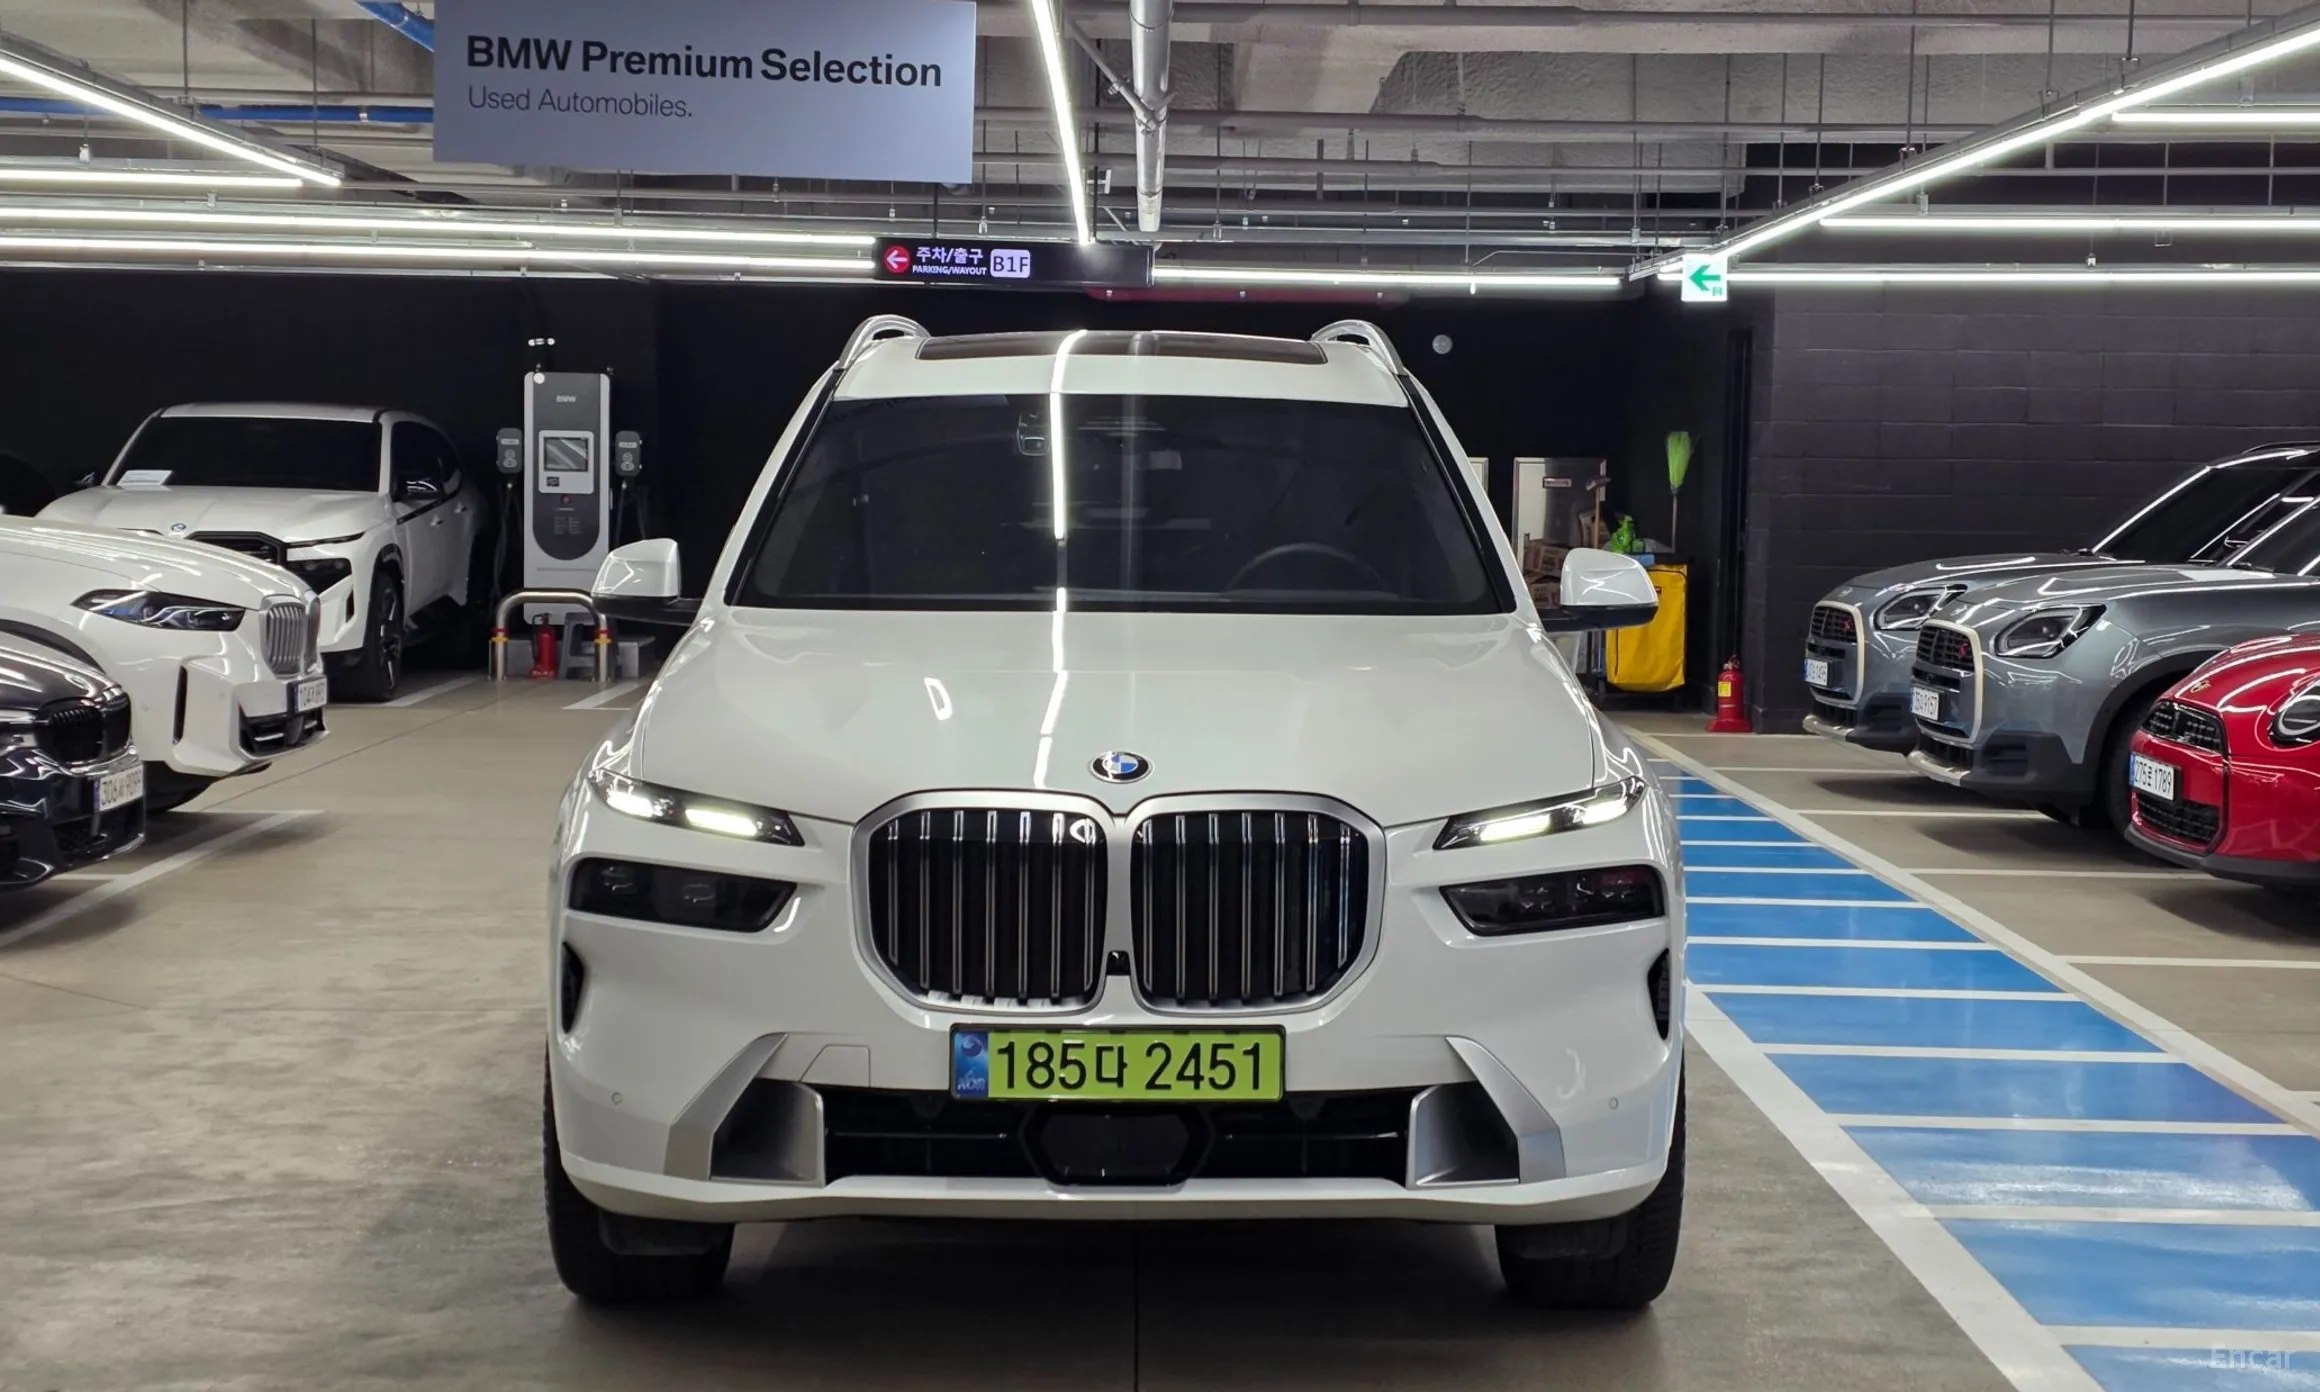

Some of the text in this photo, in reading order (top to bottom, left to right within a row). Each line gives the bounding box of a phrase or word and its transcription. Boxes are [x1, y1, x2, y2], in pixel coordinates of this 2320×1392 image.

[467, 35, 942, 87] BMW Premium Selection
[469, 86, 692, 118] Used Automobiles.
[916, 246, 984, 264] 주차/출구
[993, 255, 1029, 273] B1F
[997, 1042, 1260, 1091] 185다 2451
